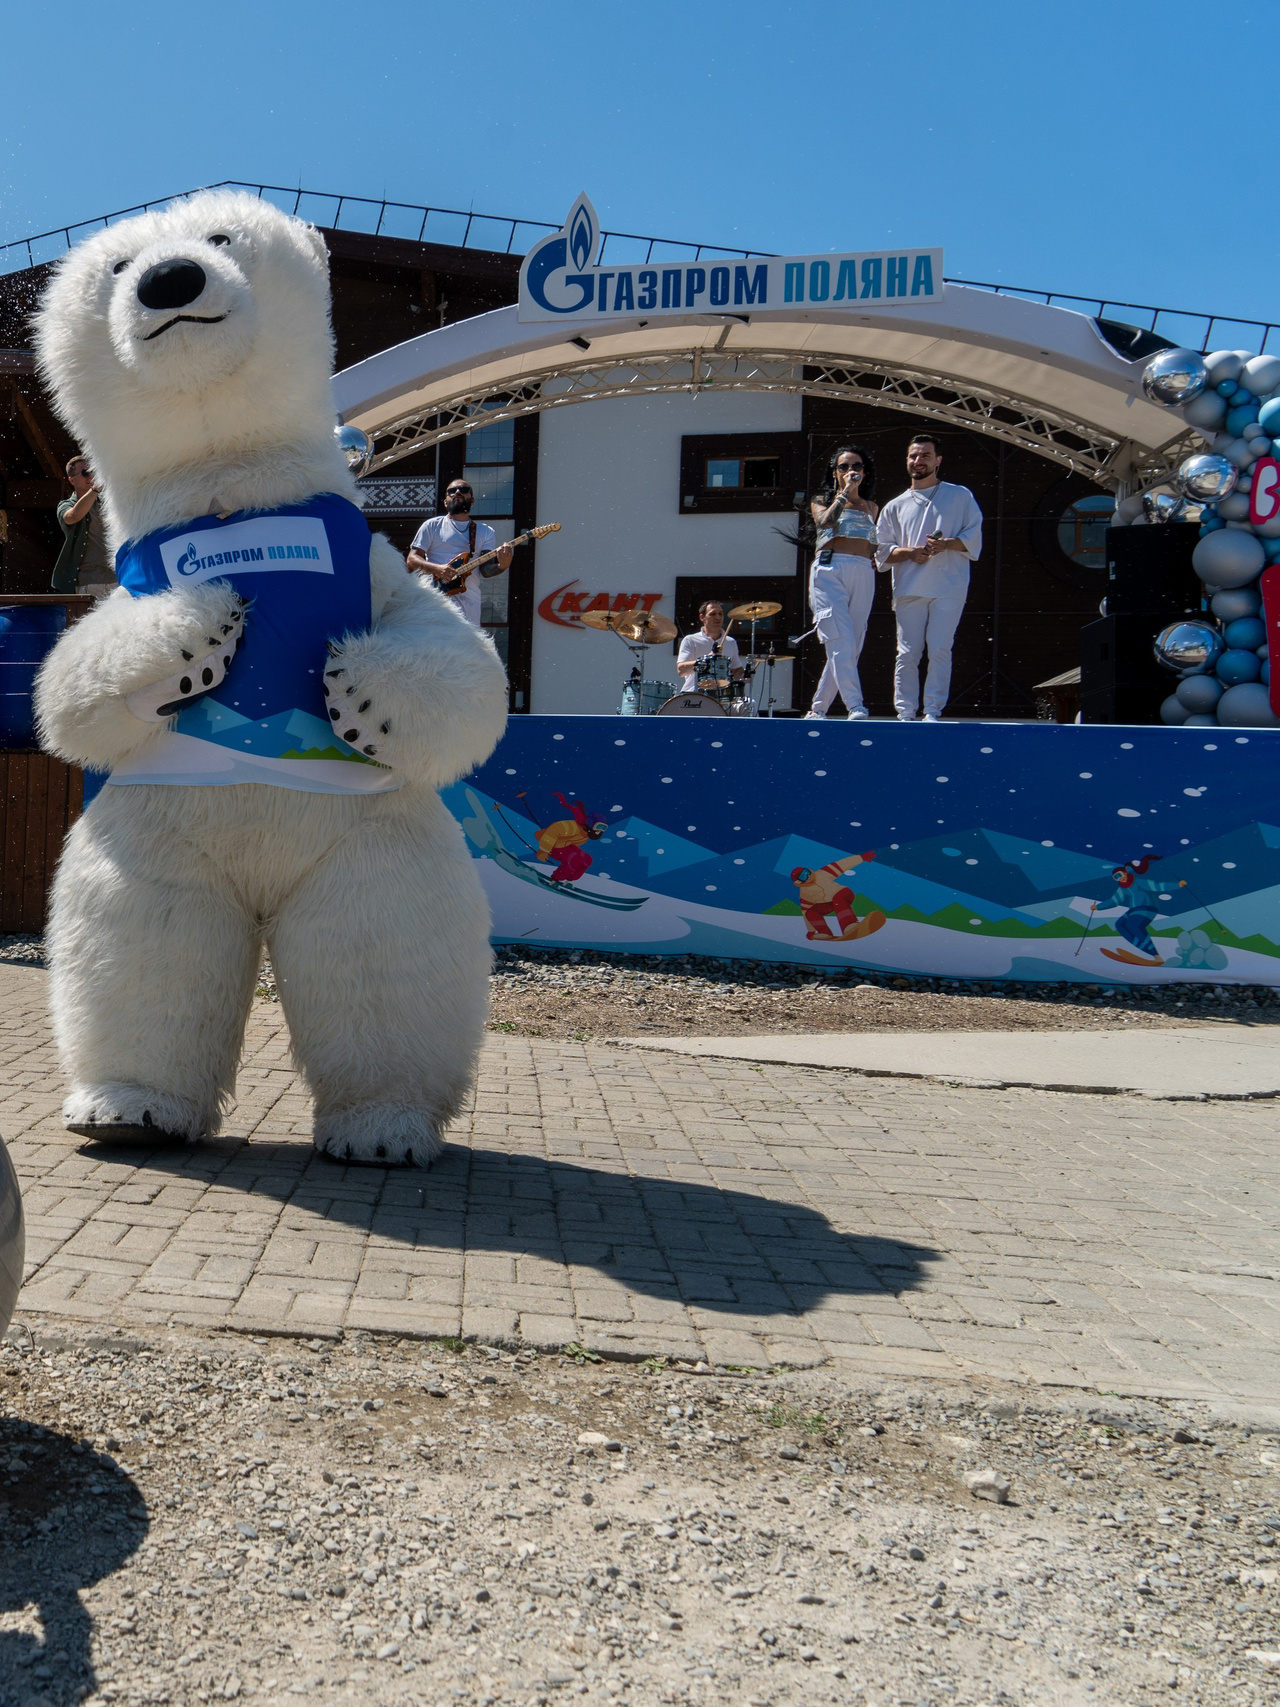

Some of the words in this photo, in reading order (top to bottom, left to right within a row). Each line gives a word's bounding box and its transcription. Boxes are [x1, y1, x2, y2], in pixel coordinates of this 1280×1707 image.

[598, 264, 768, 312] ГАЗПРОМ
[783, 255, 934, 303] ПОЛЯНА
[200, 547, 264, 570] ГАЗПРОМ
[267, 545, 320, 560] ПОЛЯНА
[557, 592, 663, 612] КАНТ
